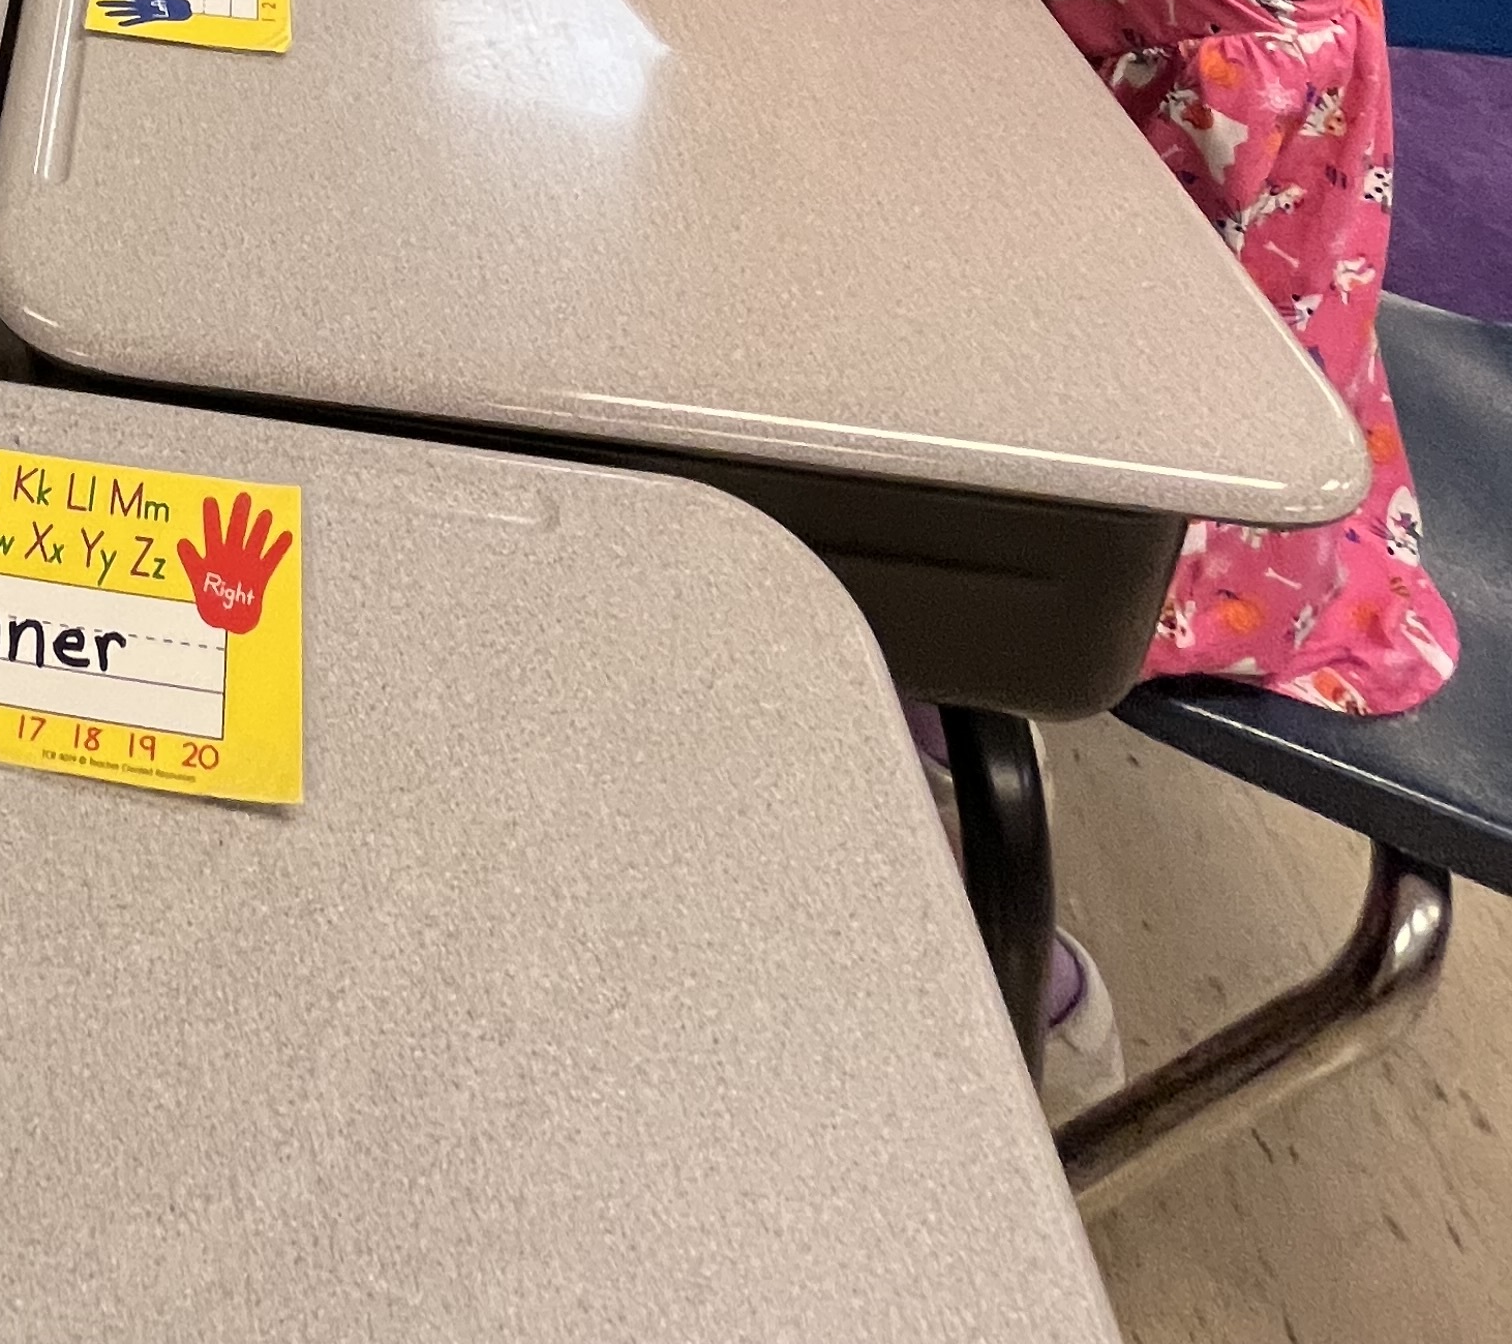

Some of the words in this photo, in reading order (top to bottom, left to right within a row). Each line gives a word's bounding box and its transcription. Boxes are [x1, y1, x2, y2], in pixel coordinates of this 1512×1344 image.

[14, 466, 51, 505] Kk
[69, 472, 95, 511] Ll
[111, 479, 170, 521] Mm
[24, 521, 64, 566] Xx
[80, 529, 116, 585] Yy
[131, 536, 165, 581] Zz
[203, 572, 255, 610] Right
[18, 715, 46, 741] 17
[74, 724, 100, 750] 18
[130, 734, 156, 761] 19
[182, 742, 219, 770] 20
